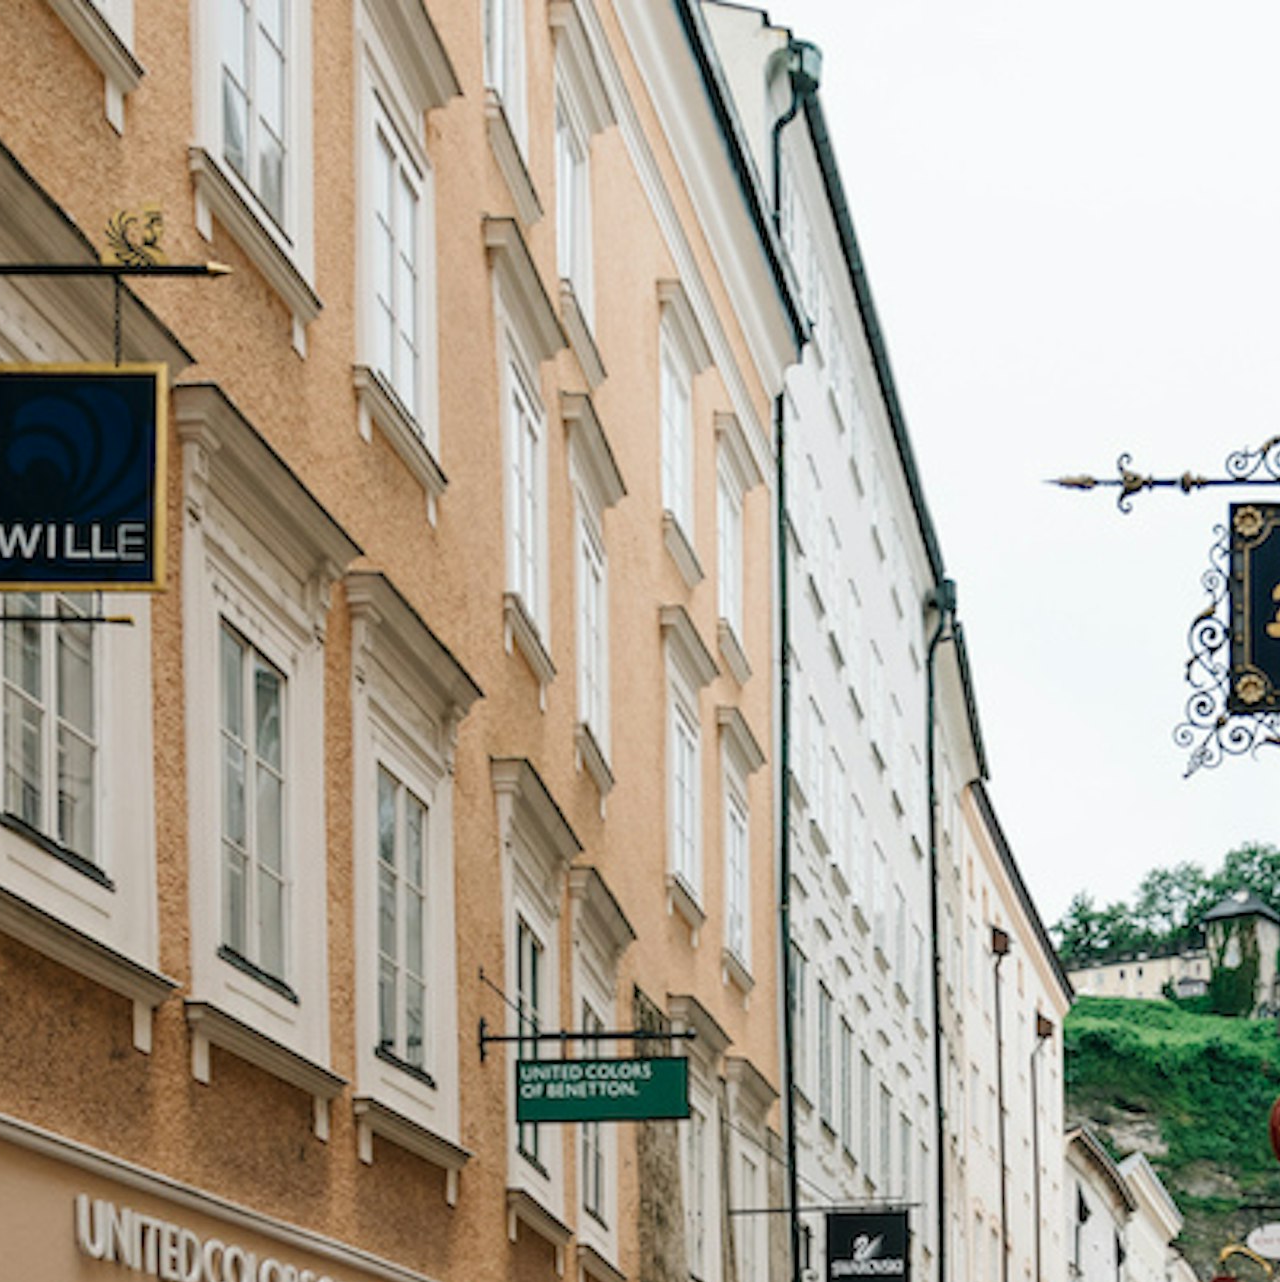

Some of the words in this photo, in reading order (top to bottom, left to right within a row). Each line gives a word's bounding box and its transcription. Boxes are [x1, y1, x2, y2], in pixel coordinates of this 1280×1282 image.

[520, 1065, 583, 1081] UNITED
[584, 1061, 653, 1080] COLORS
[520, 1083, 544, 1099] OF
